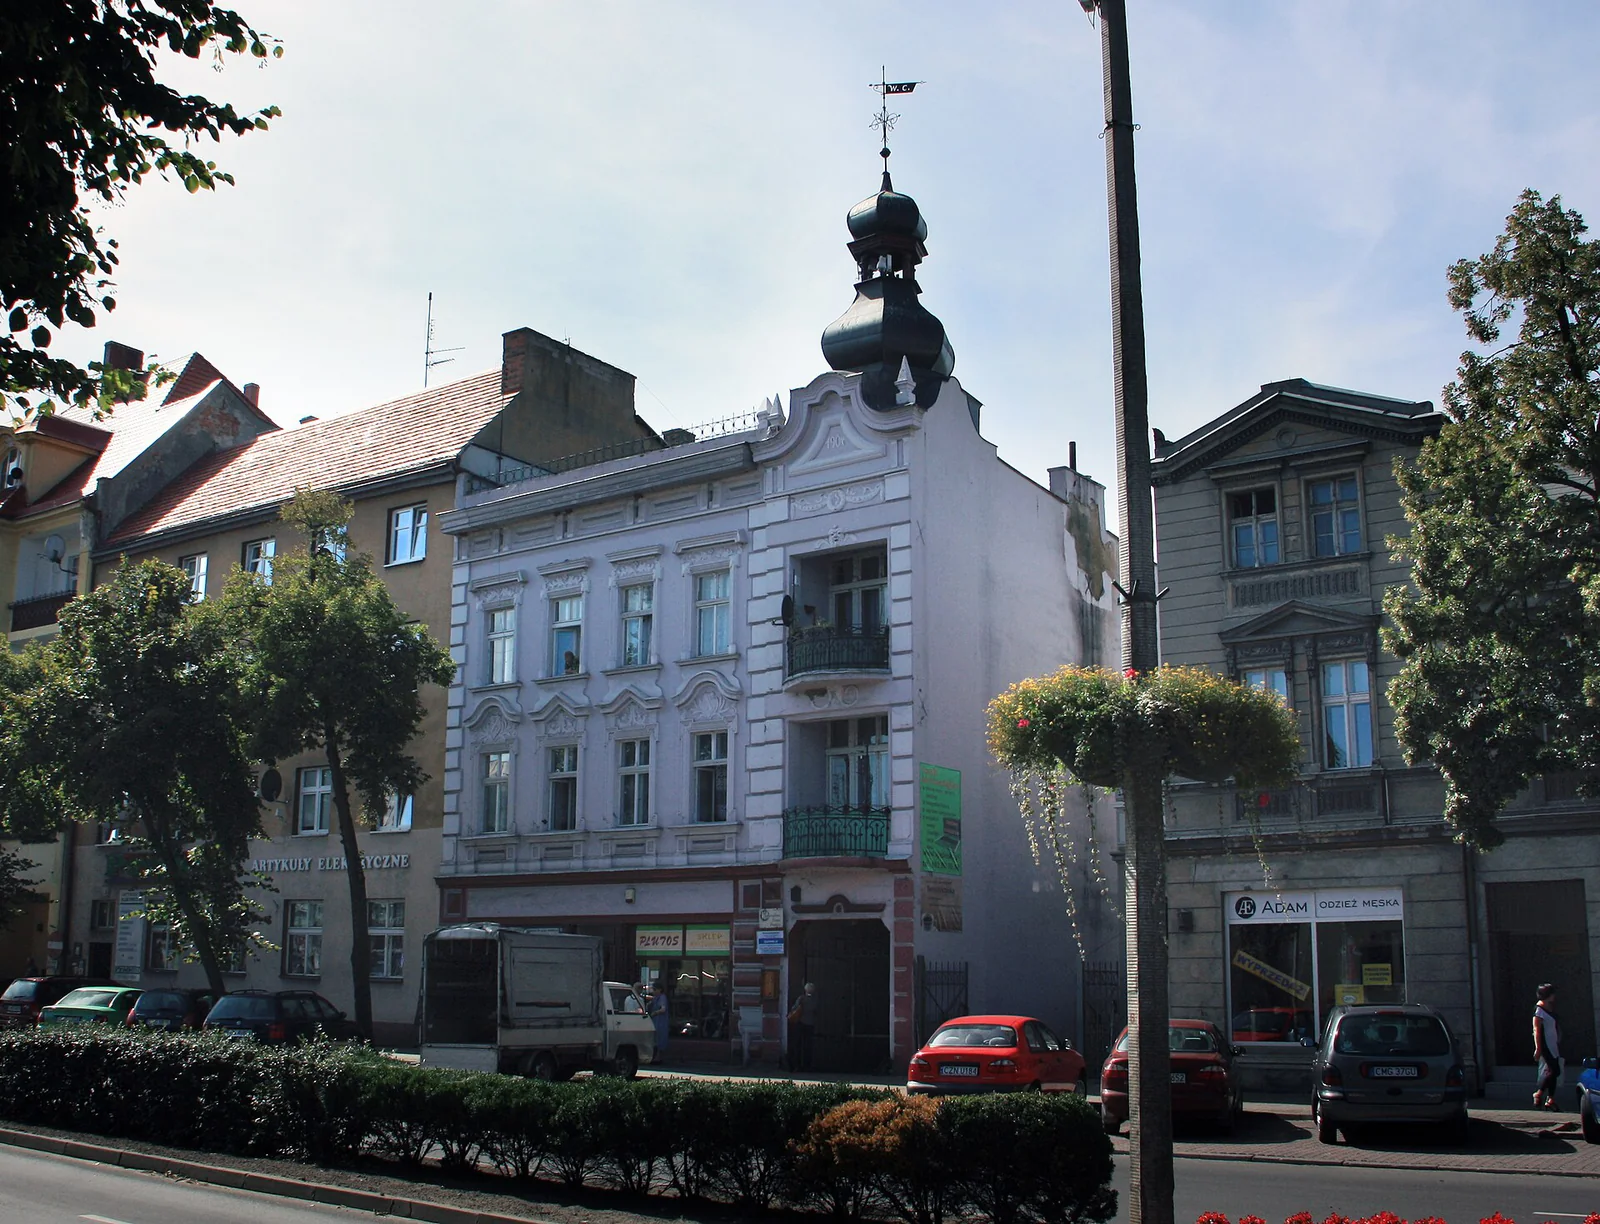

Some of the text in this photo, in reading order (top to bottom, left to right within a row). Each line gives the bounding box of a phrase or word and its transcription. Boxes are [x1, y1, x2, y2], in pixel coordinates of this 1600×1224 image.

[251, 854, 410, 872] ARTYKUŁY ELEKYCZNE
[1262, 900, 1308, 914] ADAM
[1362, 899, 1400, 909] MĘSKA
[943, 1066, 977, 1076] CZN U184
[1375, 1067, 1416, 1076] CMG 37GU
